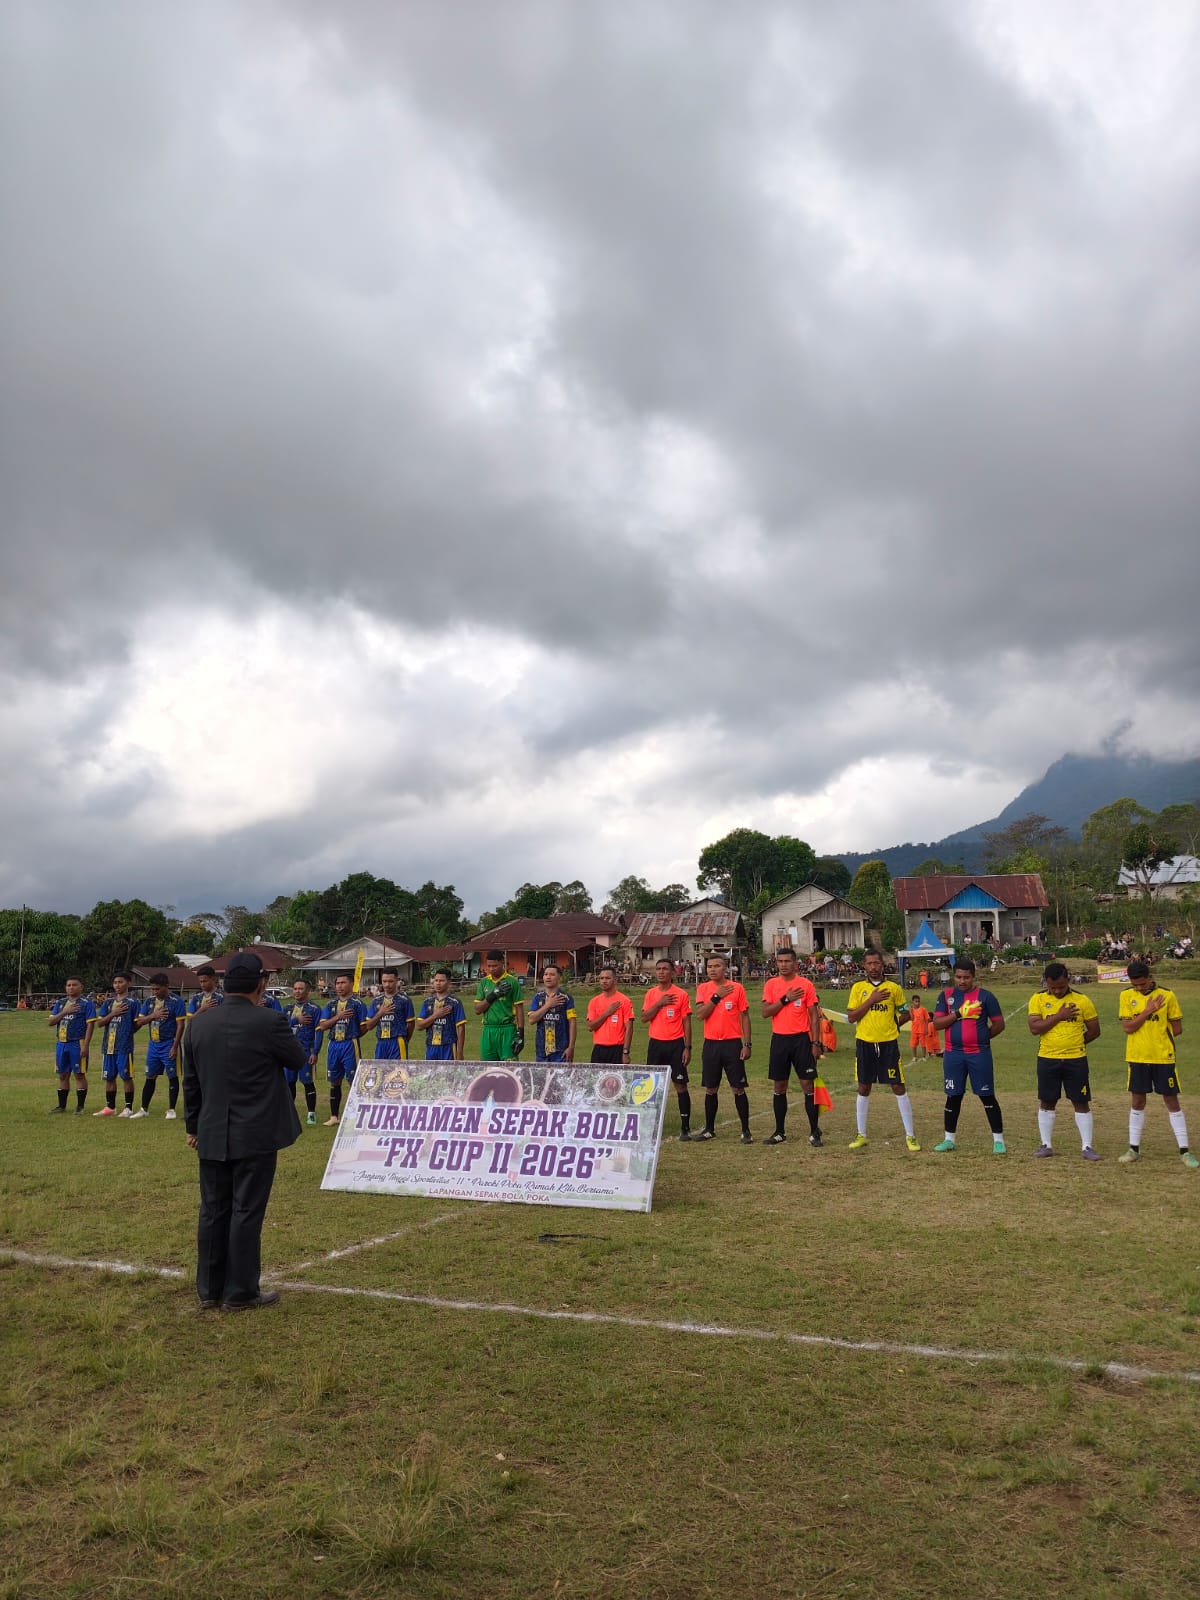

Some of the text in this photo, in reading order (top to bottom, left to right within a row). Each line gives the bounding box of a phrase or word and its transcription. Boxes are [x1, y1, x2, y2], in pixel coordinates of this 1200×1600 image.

[887, 1068, 897, 1079] 12
[945, 1079, 955, 1090] 24
[1167, 1077, 1174, 1088] 8
[1080, 1085, 1087, 1096] 4
[356, 1104, 639, 1141] TURNAMEN SEPAK BOLA
[428, 1139, 484, 1172] CUP
[488, 1142, 513, 1174] II
[429, 1188, 550, 1202] LAPANGAN SEPAK BOLA POKA
